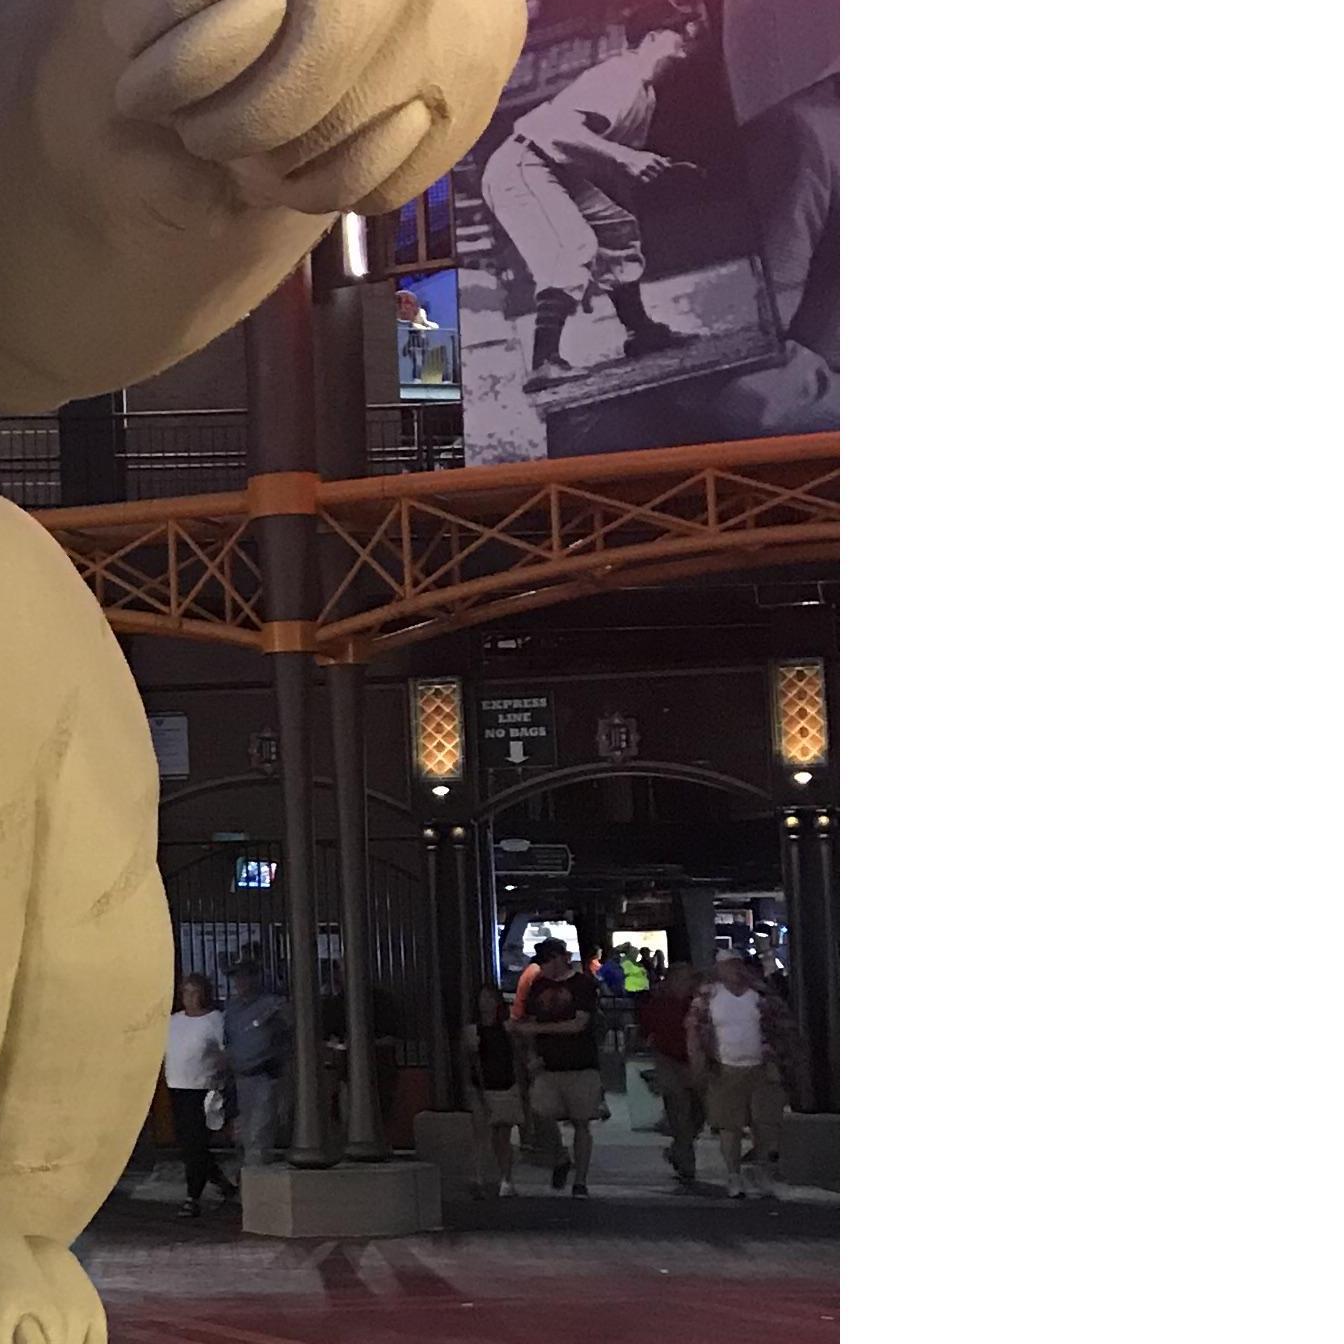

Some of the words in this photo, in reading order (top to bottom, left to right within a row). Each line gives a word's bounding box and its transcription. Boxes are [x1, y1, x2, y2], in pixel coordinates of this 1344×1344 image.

[481, 698, 547, 710] EXPRESS
[498, 713, 531, 723] LINE
[485, 729, 506, 738] NO
[510, 727, 546, 737] BAGS
